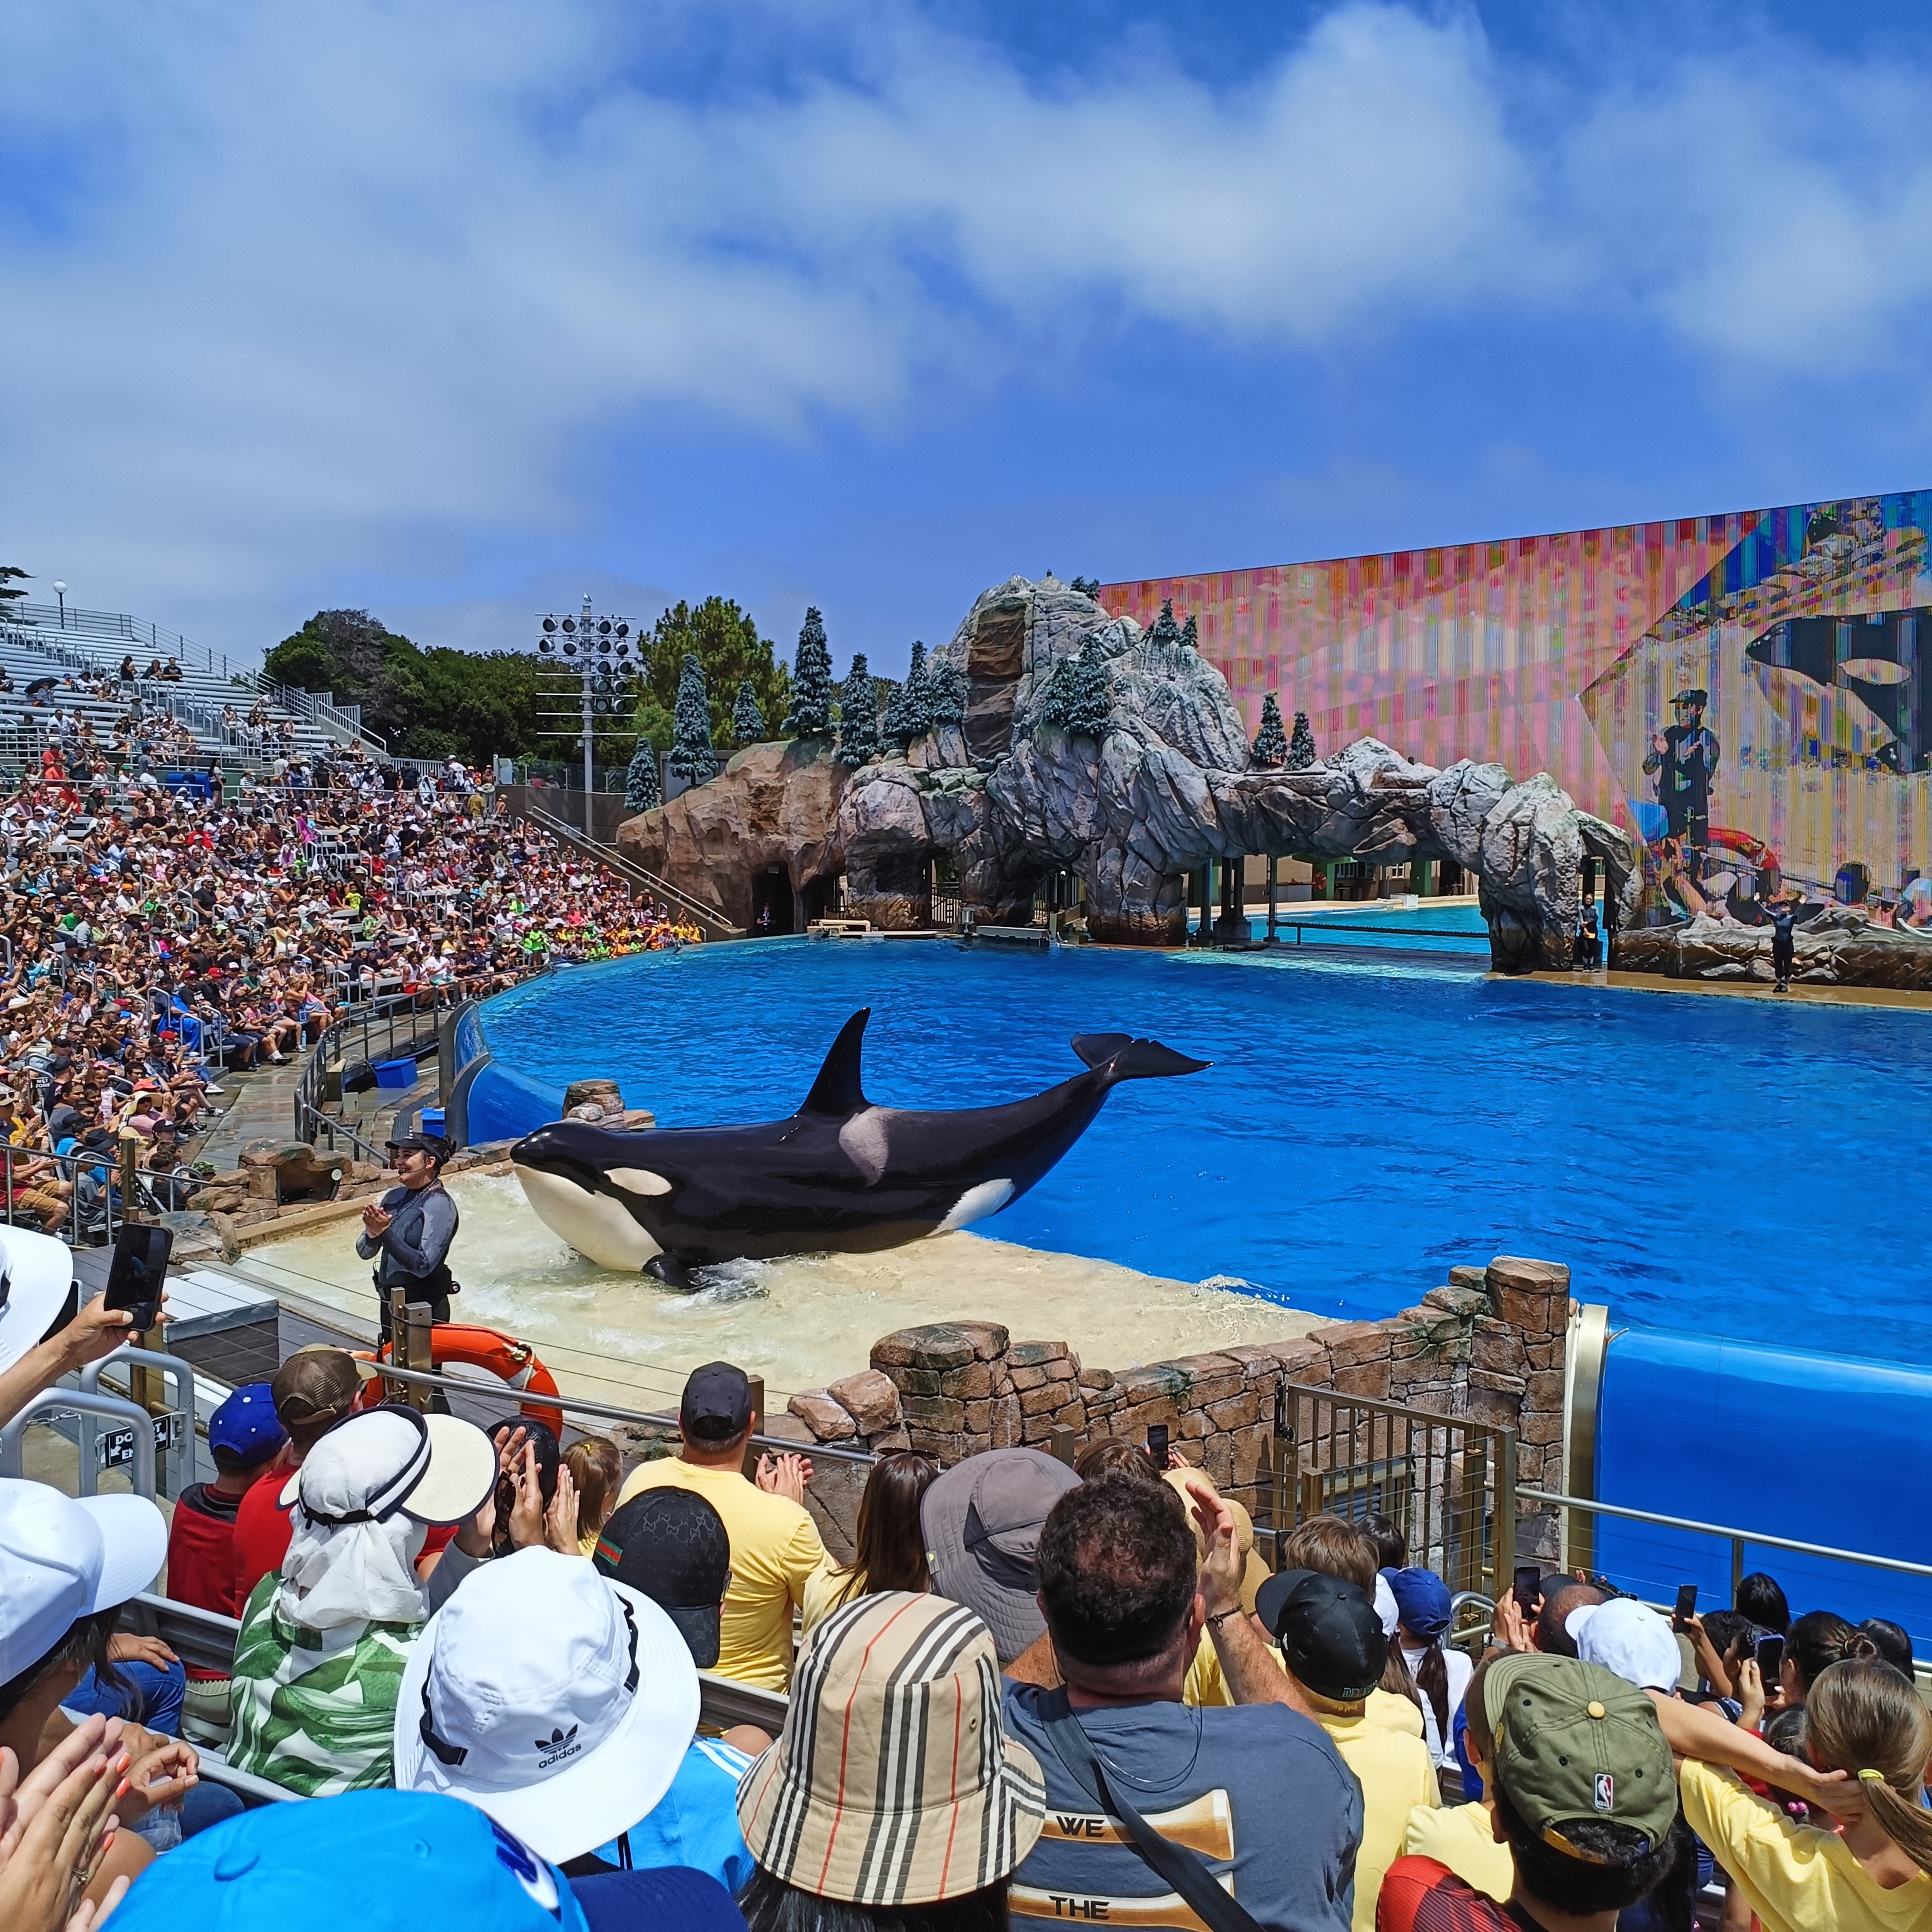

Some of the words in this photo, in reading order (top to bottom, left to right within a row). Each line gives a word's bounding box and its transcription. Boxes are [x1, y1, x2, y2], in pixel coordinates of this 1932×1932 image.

[115, 1432, 133, 1445] DO
[538, 1743, 582, 1769] adidas
[1055, 1815, 1106, 1838] WE
[1048, 1895, 1111, 1921] THE
